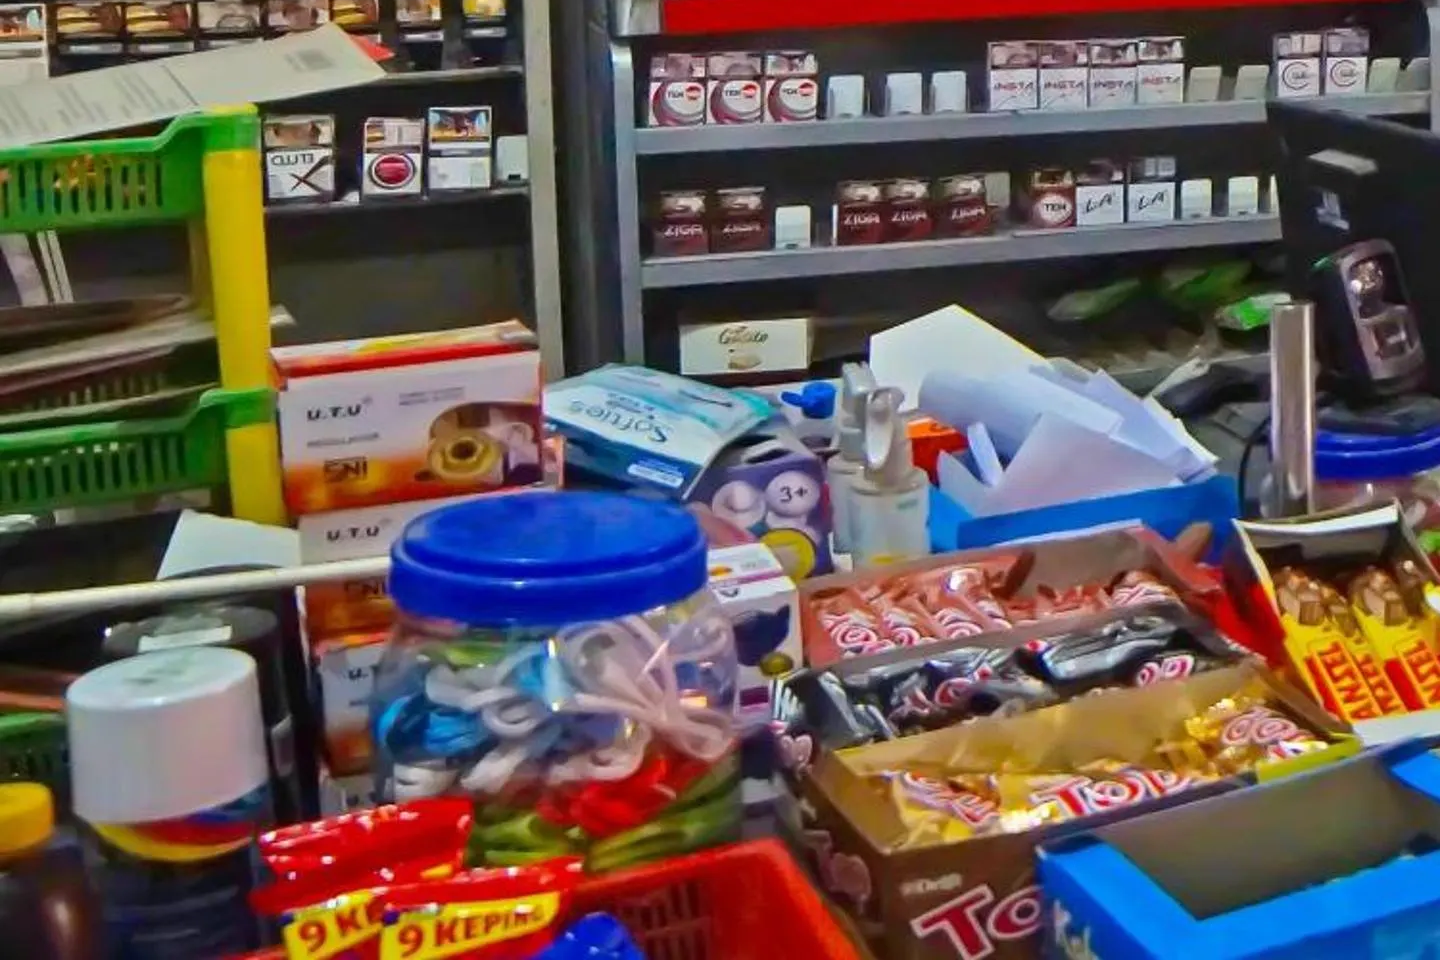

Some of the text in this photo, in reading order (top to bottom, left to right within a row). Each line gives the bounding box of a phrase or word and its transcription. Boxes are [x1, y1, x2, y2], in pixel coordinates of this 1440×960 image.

[299, 920, 328, 952] 9
[909, 884, 1043, 960] TO
[398, 924, 425, 957] 9
